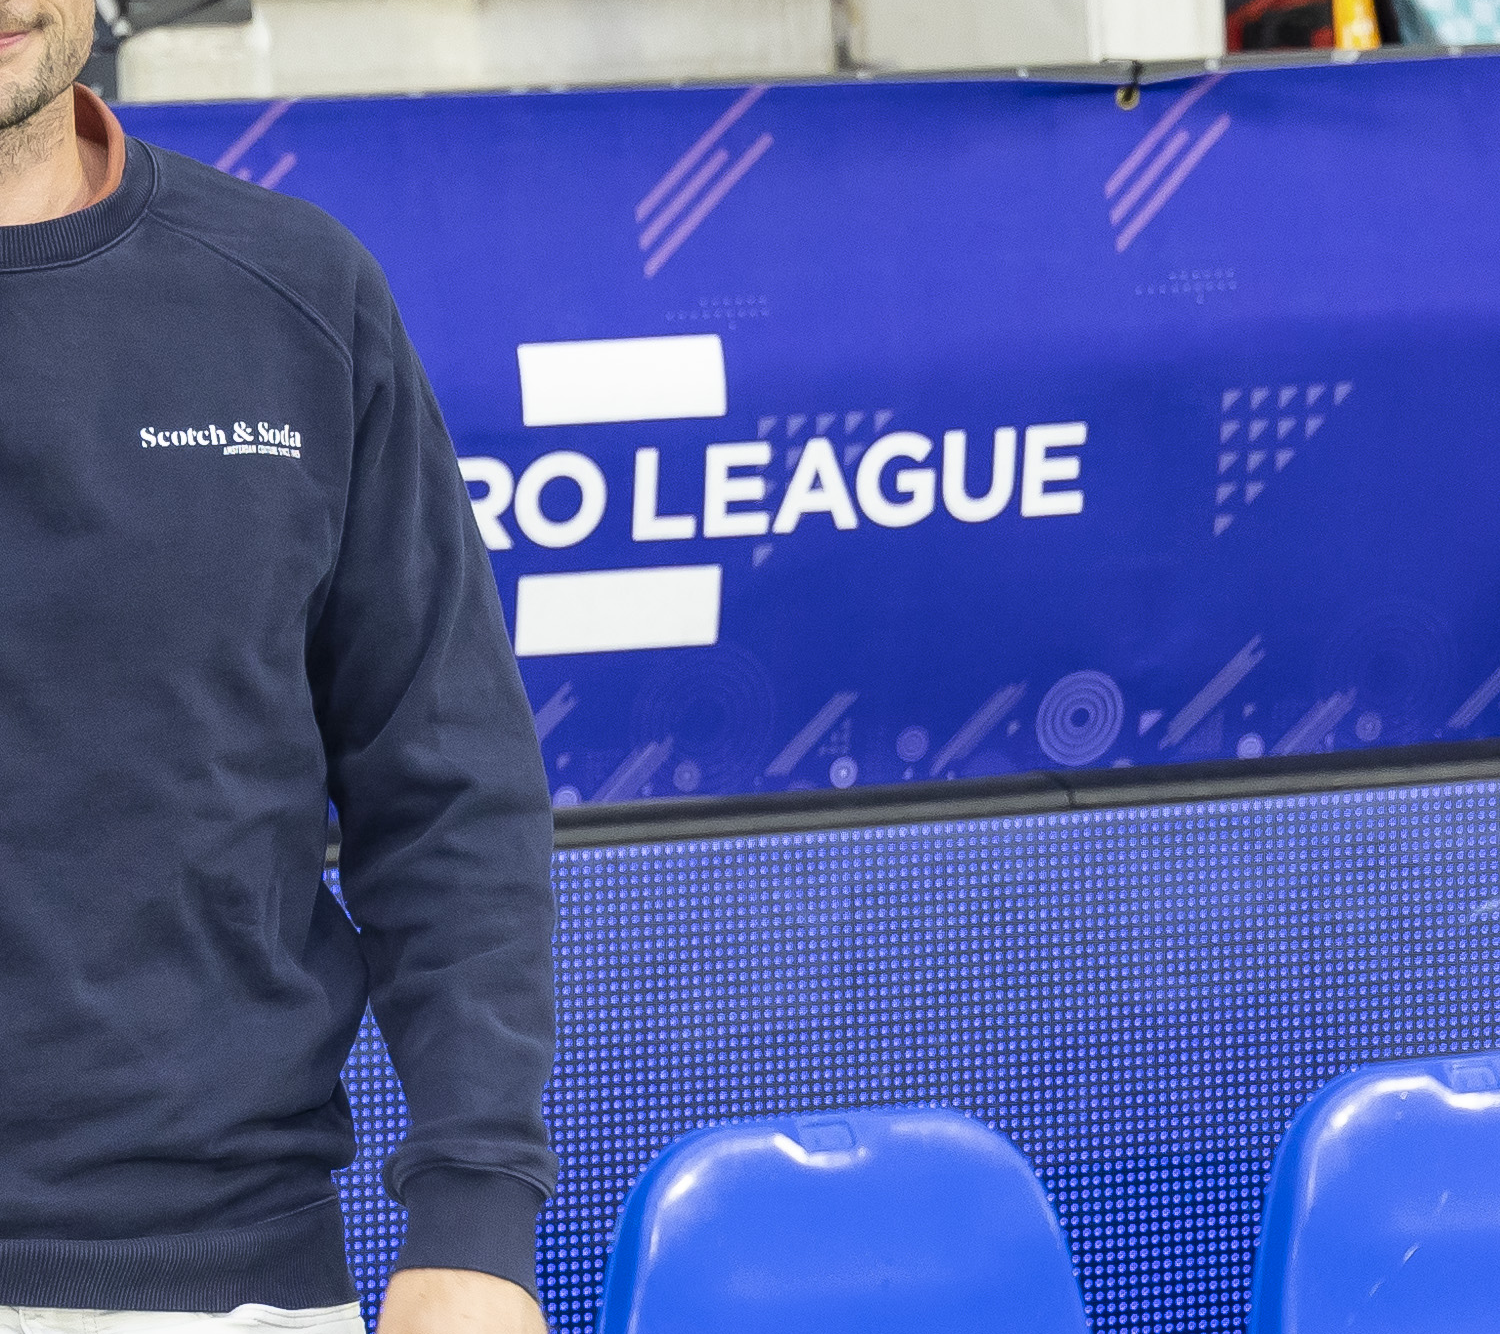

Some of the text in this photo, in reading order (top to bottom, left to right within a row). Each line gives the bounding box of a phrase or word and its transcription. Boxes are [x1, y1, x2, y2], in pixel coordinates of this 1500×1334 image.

[140, 421, 302, 448] Scotch & Soda
[632, 422, 1087, 542] LEAGUE
